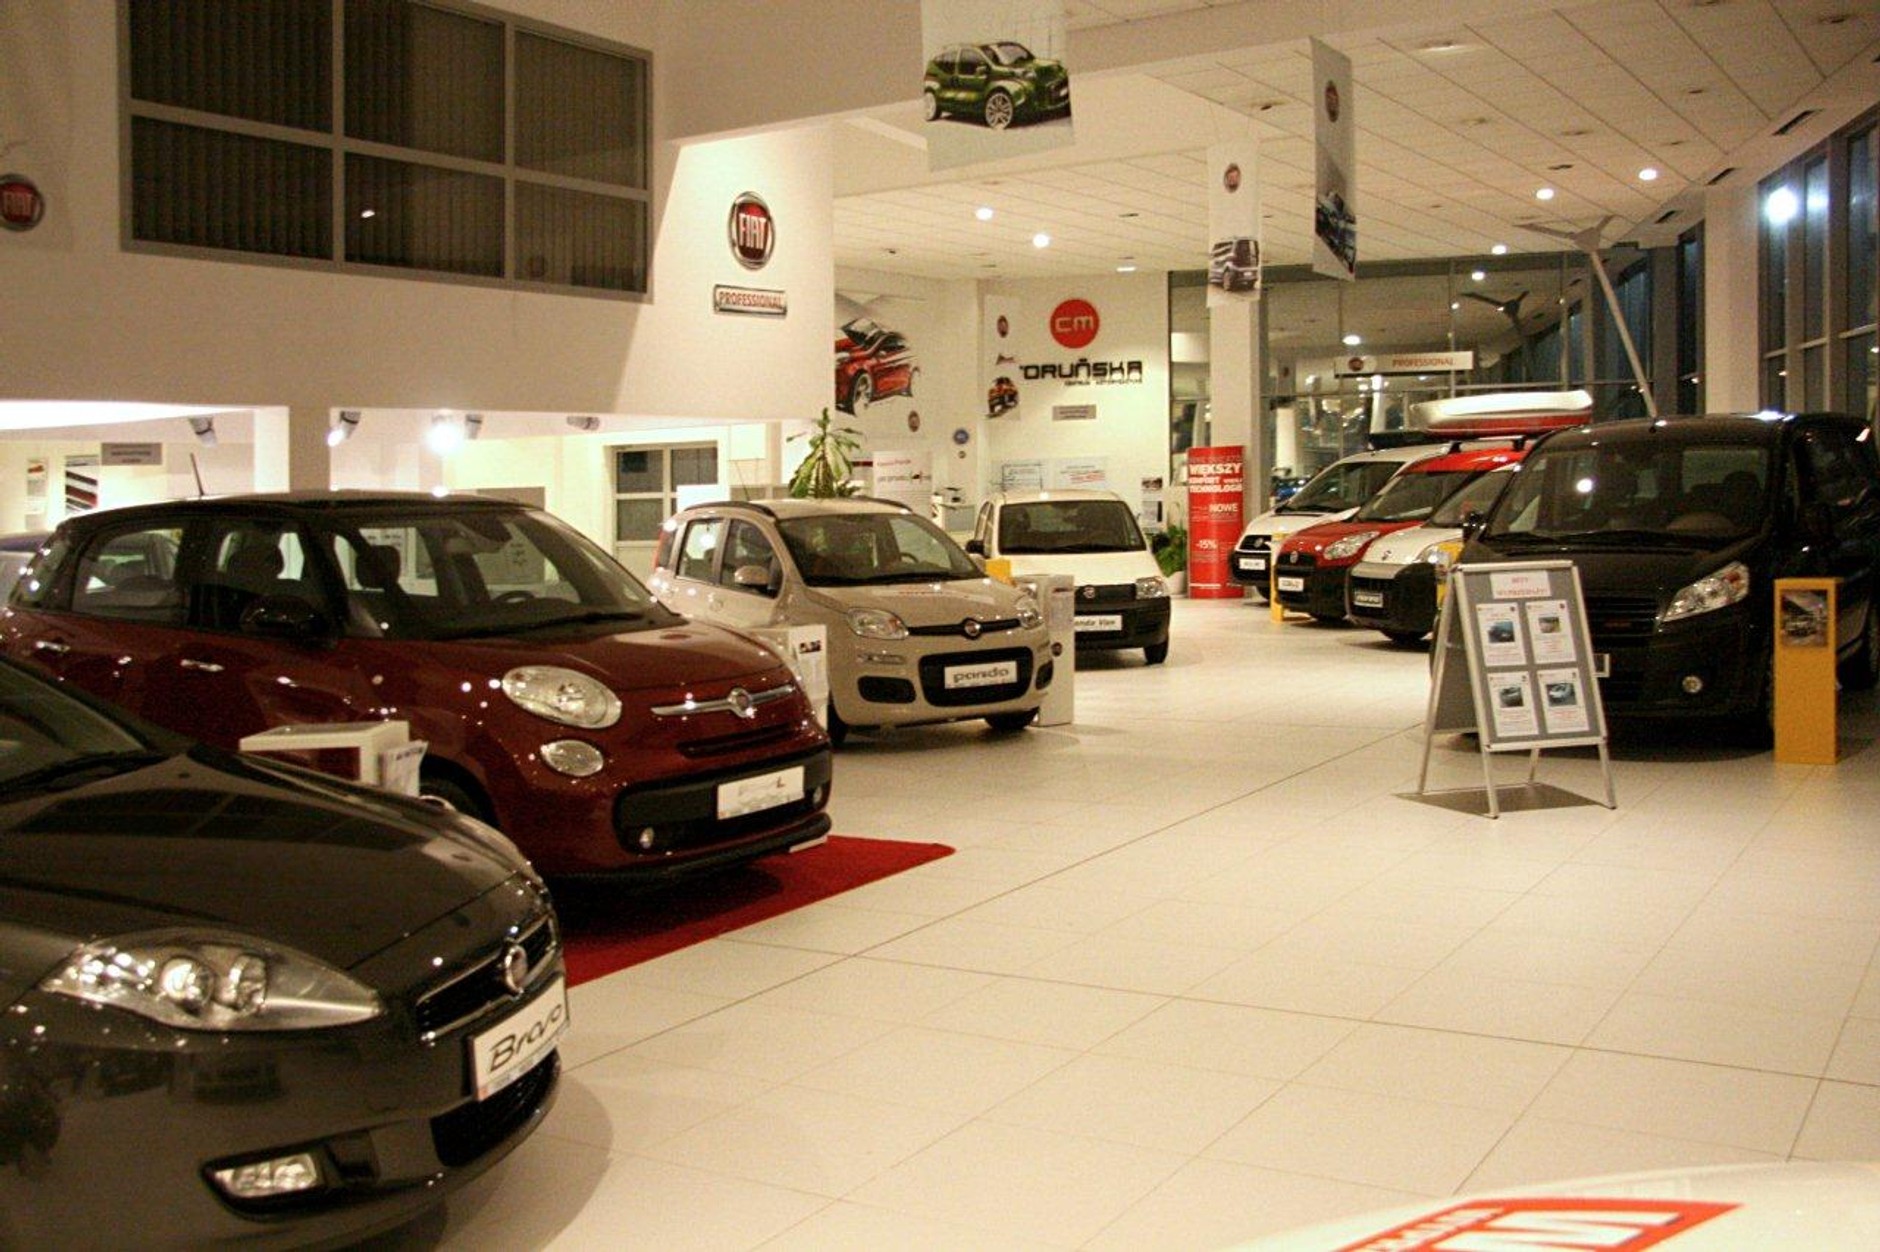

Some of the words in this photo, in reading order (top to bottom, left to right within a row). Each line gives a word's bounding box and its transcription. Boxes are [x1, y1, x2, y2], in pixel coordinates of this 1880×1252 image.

[739, 213, 767, 249] FIAT
[719, 291, 784, 309] PROFESSIONAL
[1019, 358, 1142, 380] ORUŃSKA
[489, 1003, 562, 1073] Bravo
